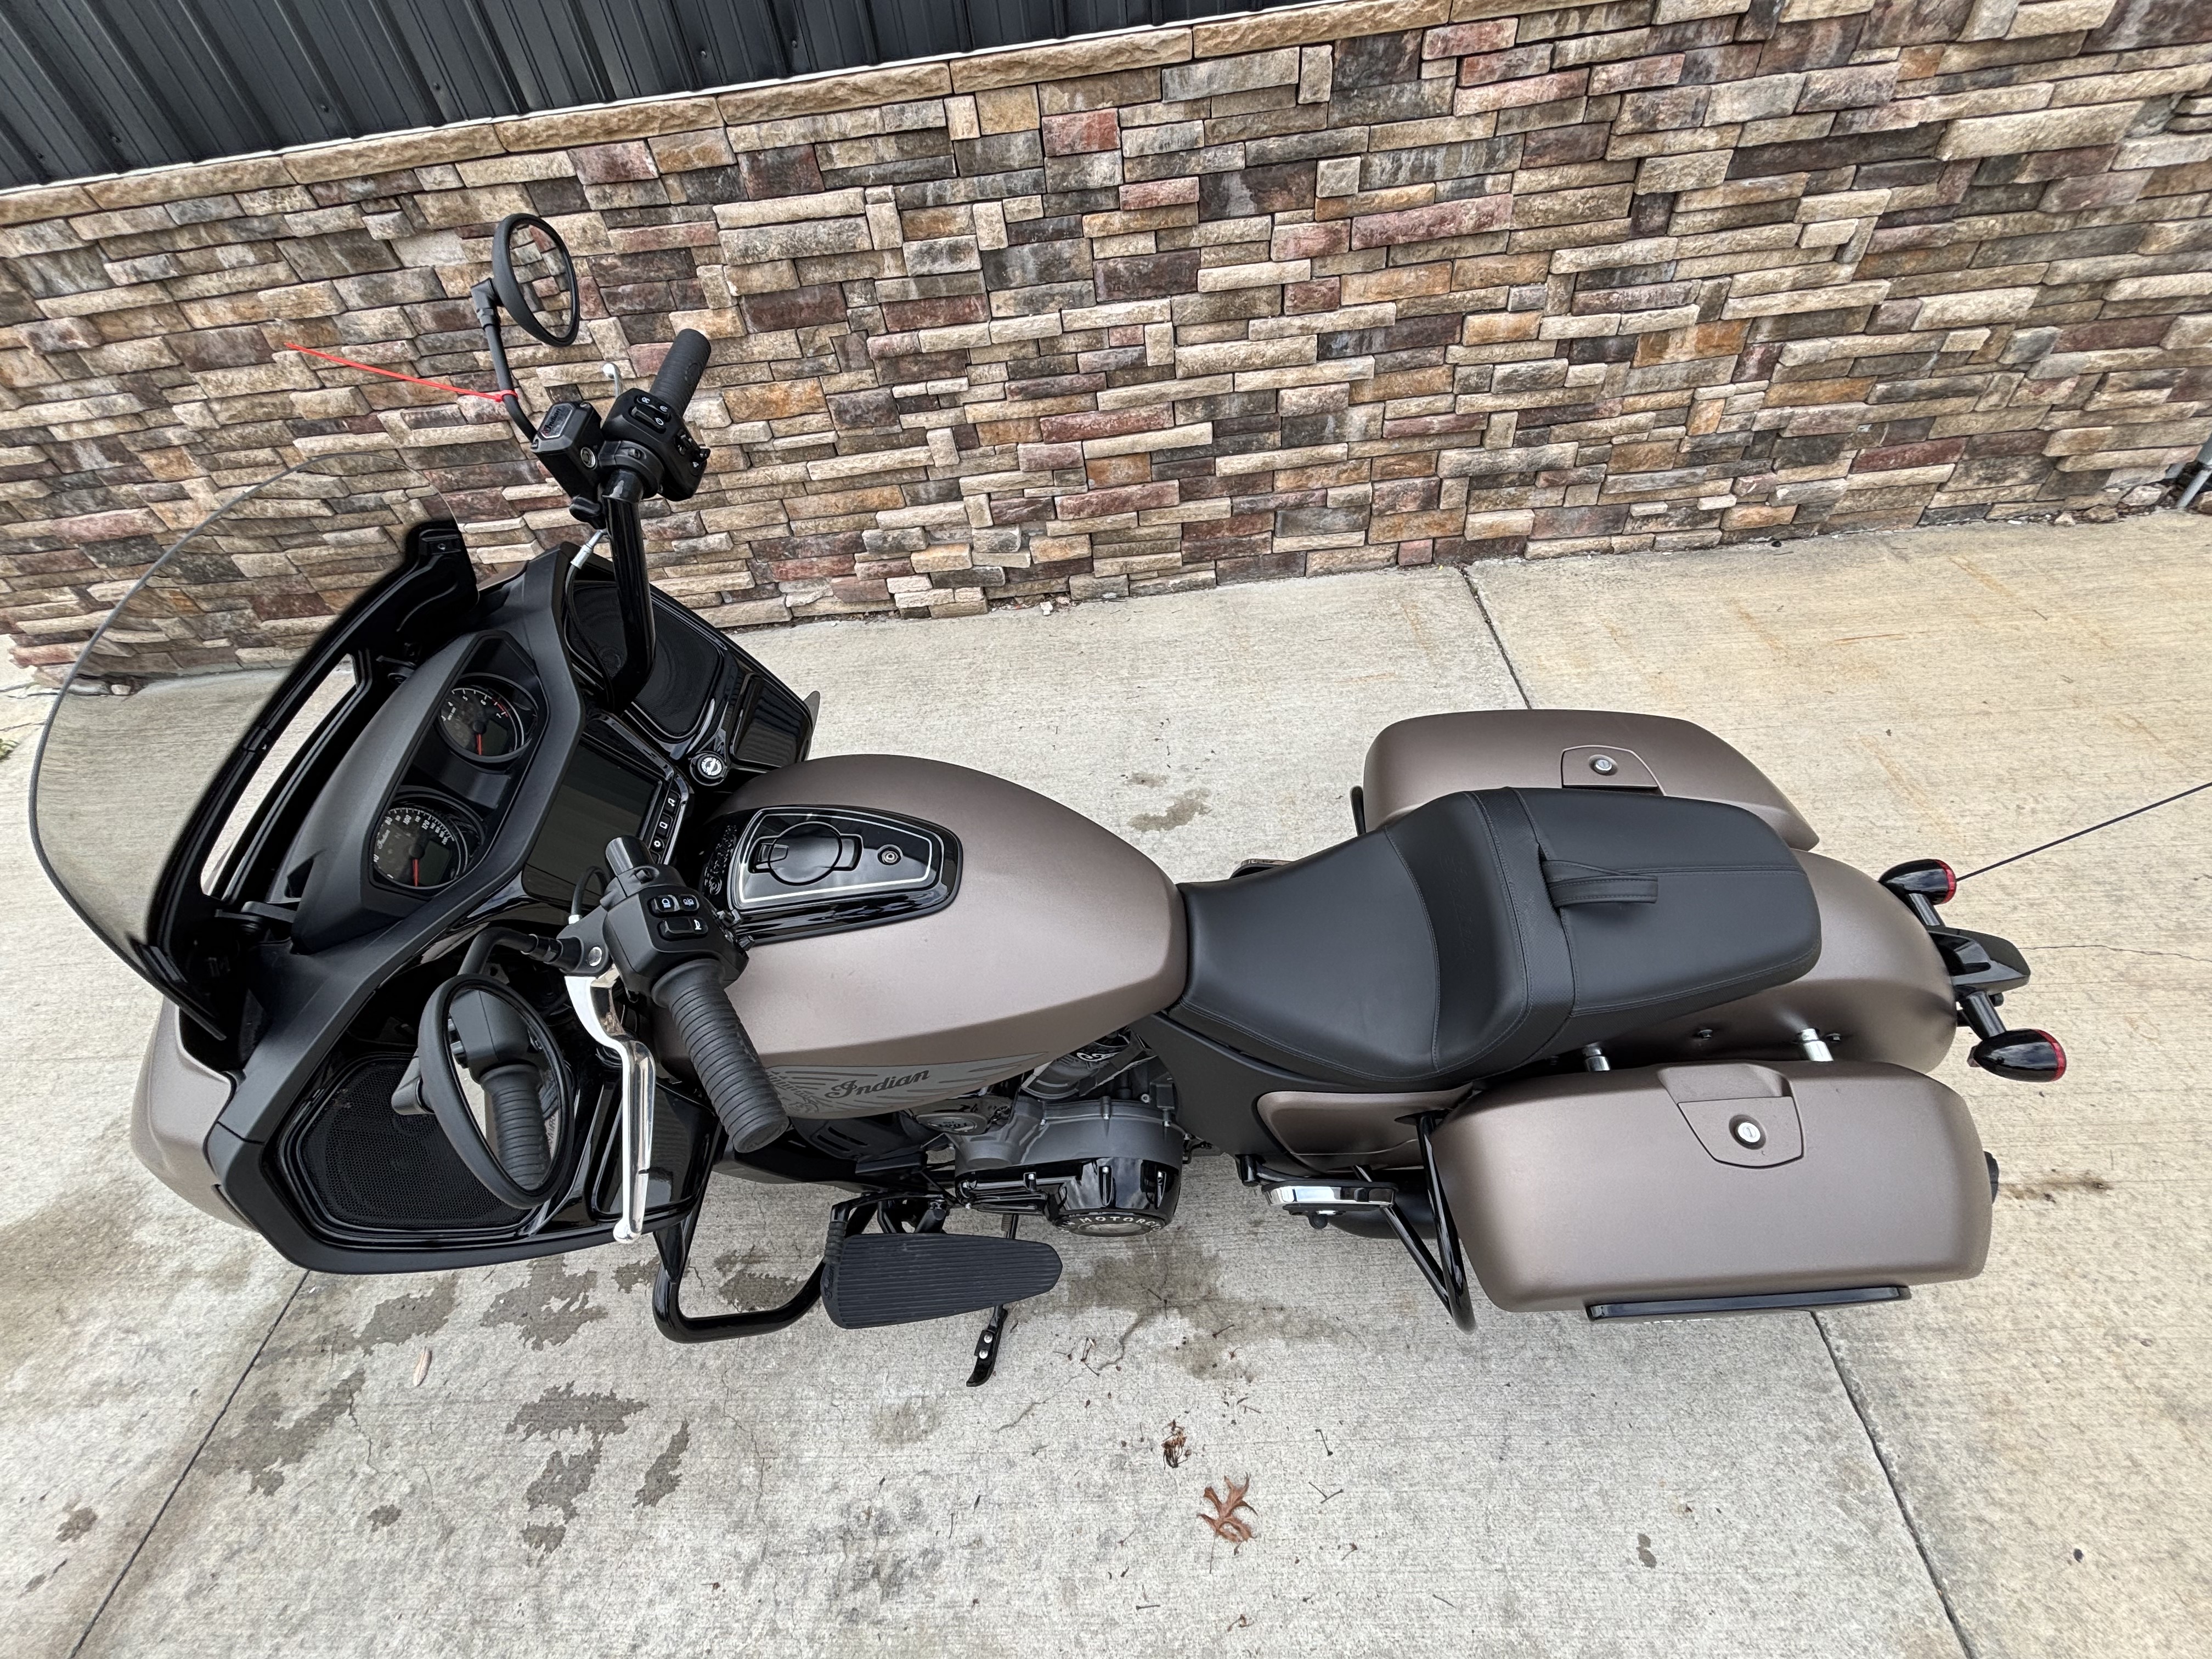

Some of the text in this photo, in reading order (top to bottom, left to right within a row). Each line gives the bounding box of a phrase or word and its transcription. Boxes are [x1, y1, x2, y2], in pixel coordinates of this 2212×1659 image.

[403, 814, 412, 825] 100
[421, 820, 430, 830] 120
[824, 1070, 931, 1099] Indian
